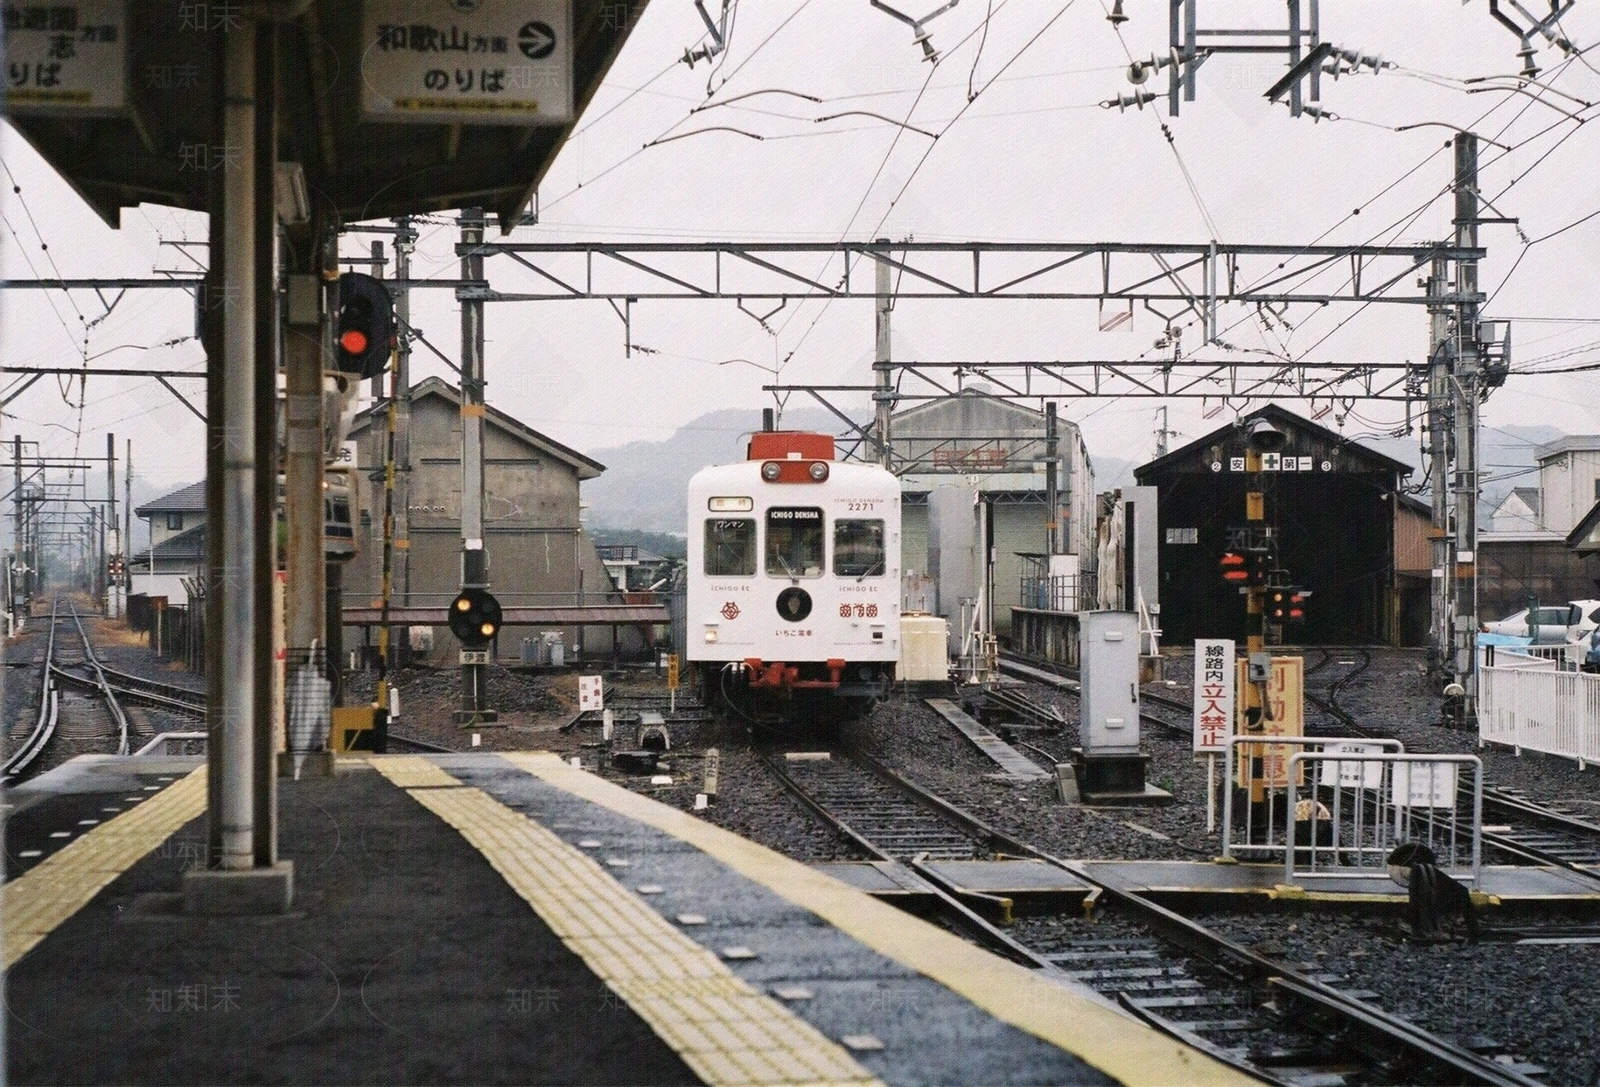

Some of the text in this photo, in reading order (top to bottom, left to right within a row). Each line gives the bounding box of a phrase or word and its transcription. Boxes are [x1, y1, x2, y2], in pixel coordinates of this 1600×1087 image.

[424, 67, 505, 93] のりば
[848, 503, 874, 511] 2271
[771, 511, 819, 519] ICHIGO DENSHA
[717, 520, 745, 529] ワンマン
[1201, 645, 1227, 747] 線路内立入禁止
